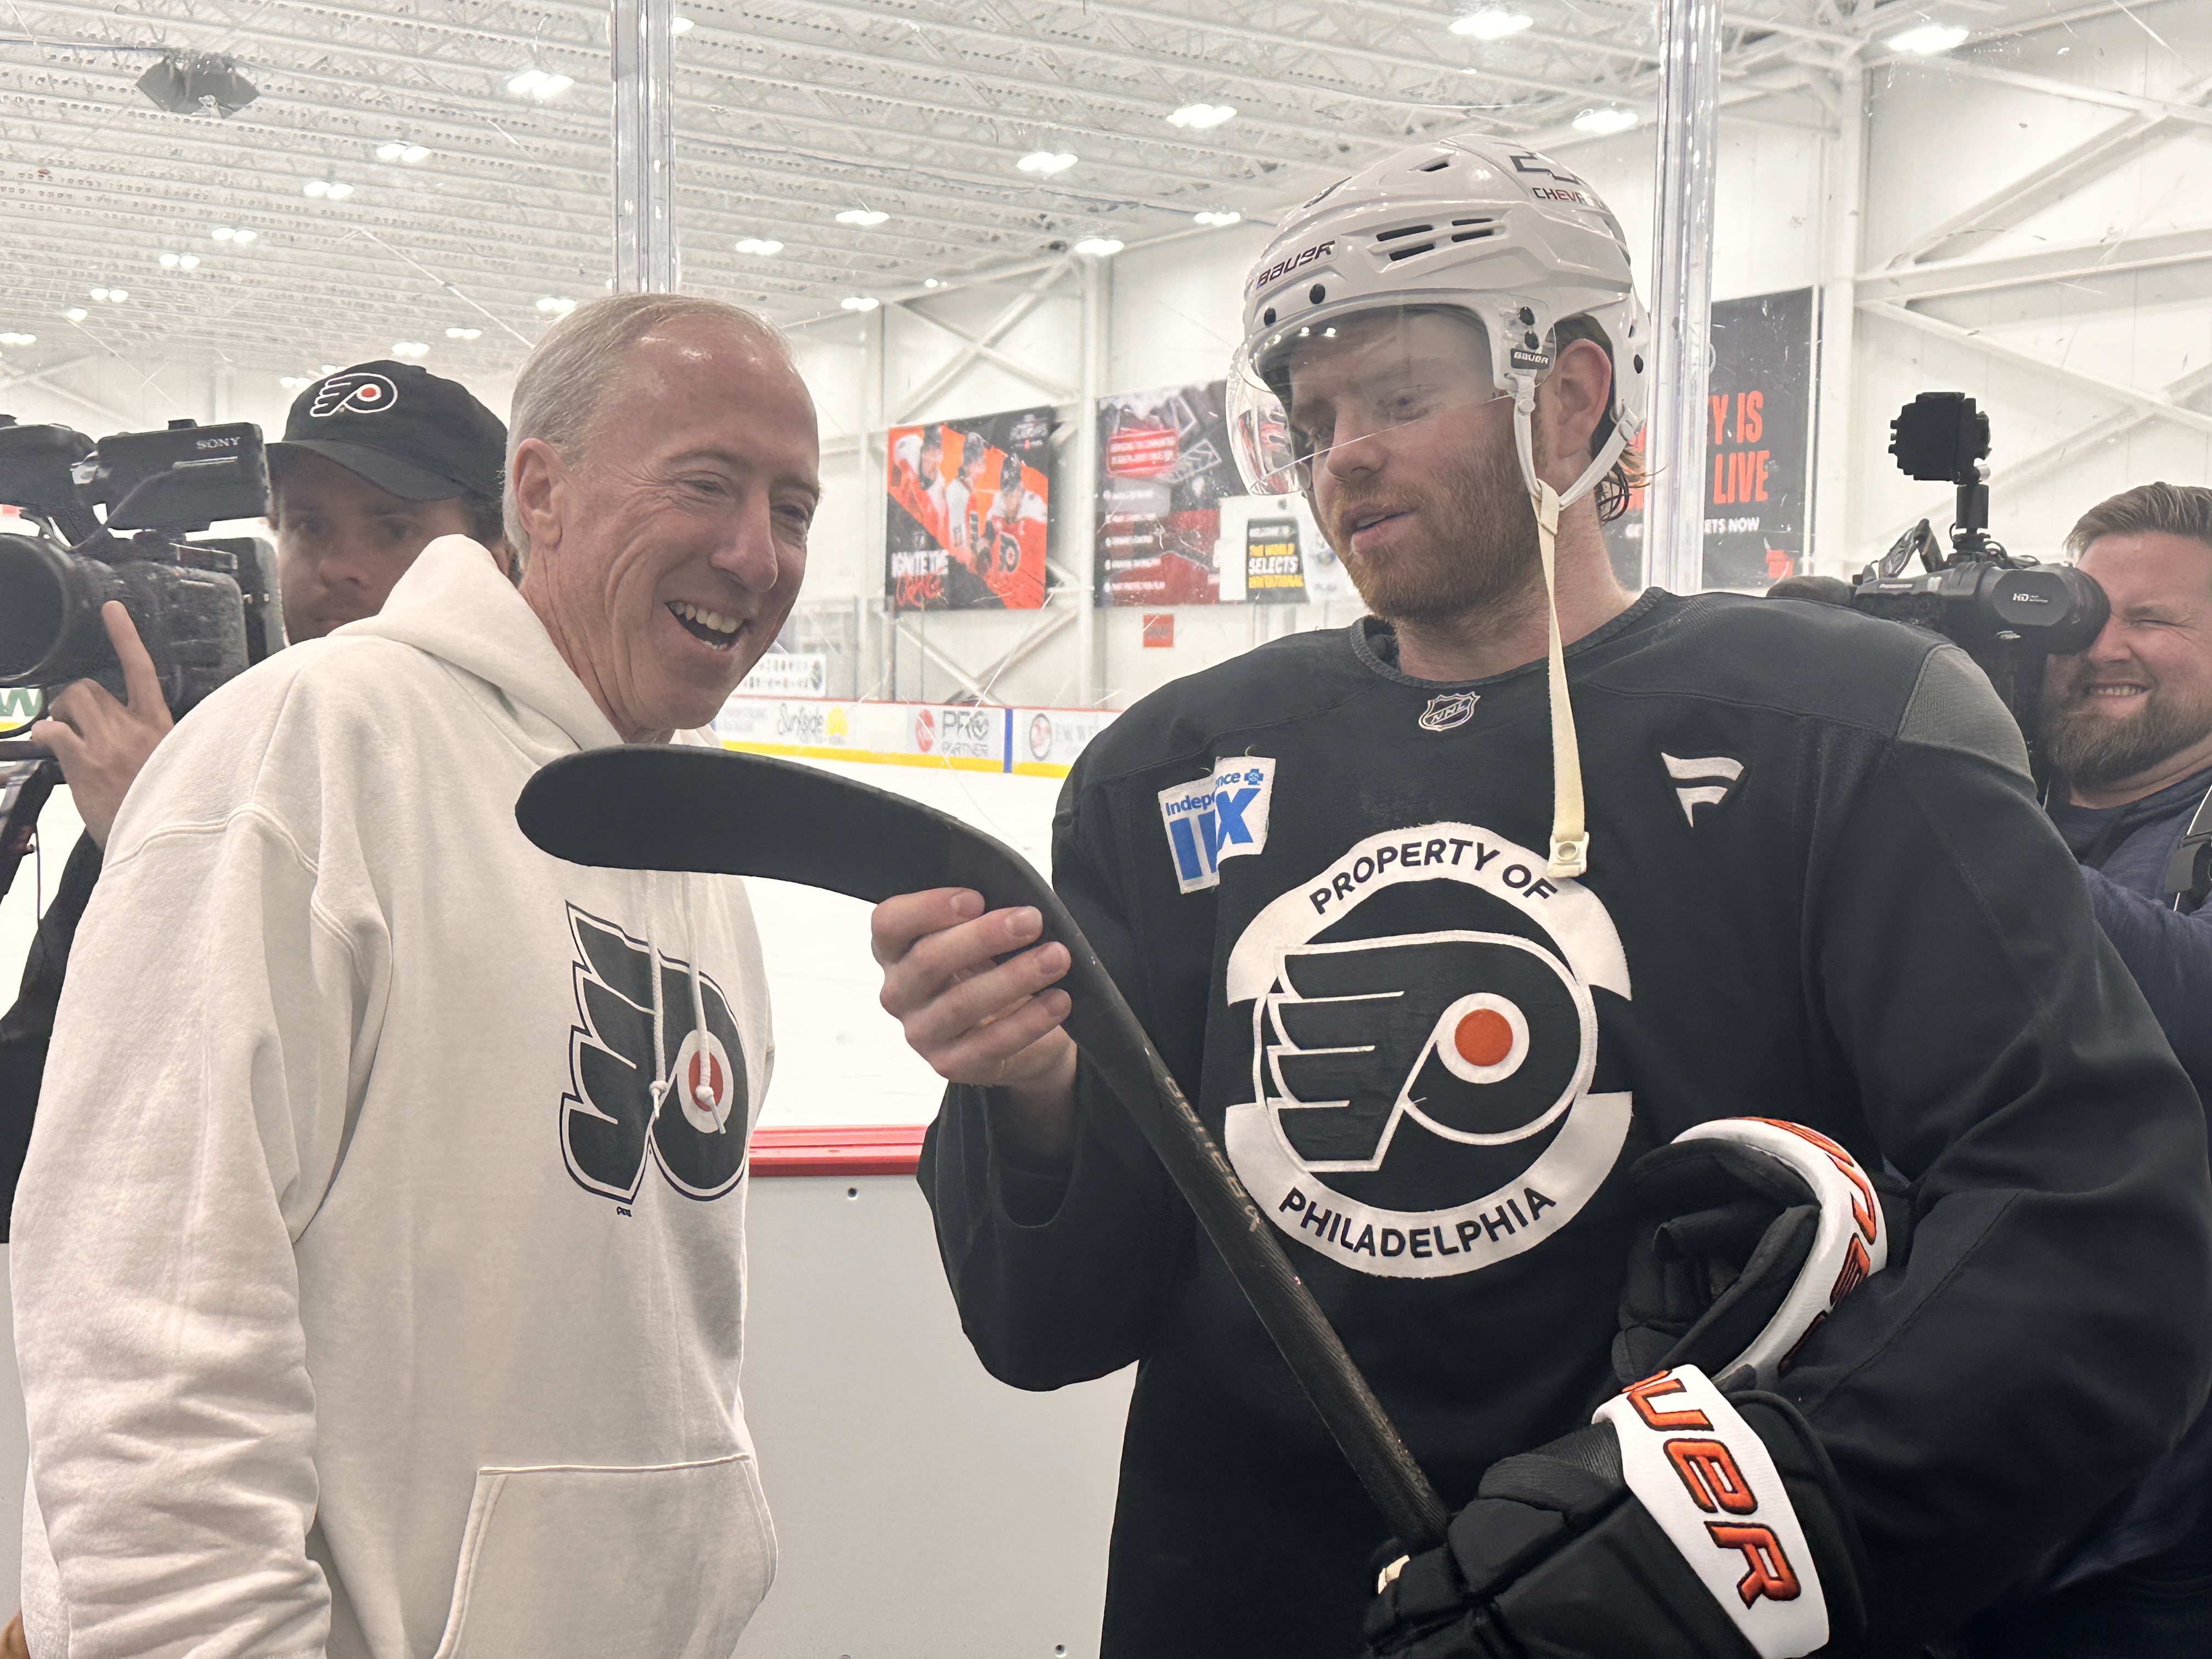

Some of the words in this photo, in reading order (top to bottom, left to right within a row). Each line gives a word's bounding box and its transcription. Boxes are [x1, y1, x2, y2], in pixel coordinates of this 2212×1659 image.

[1256, 240, 1335, 290] BAUER
[1737, 391, 1763, 443] IS
[196, 437, 241, 449] SONY
[1714, 450, 1770, 504] LIVE
[1728, 517, 1759, 533] NOW
[1248, 556, 1299, 574] SELECTS
[1430, 702, 1466, 725] NHL
[1310, 838, 1500, 915] PROPERTY
[1502, 864, 1558, 900] OF
[1279, 1187, 1556, 1259] PHILADELPHIA
